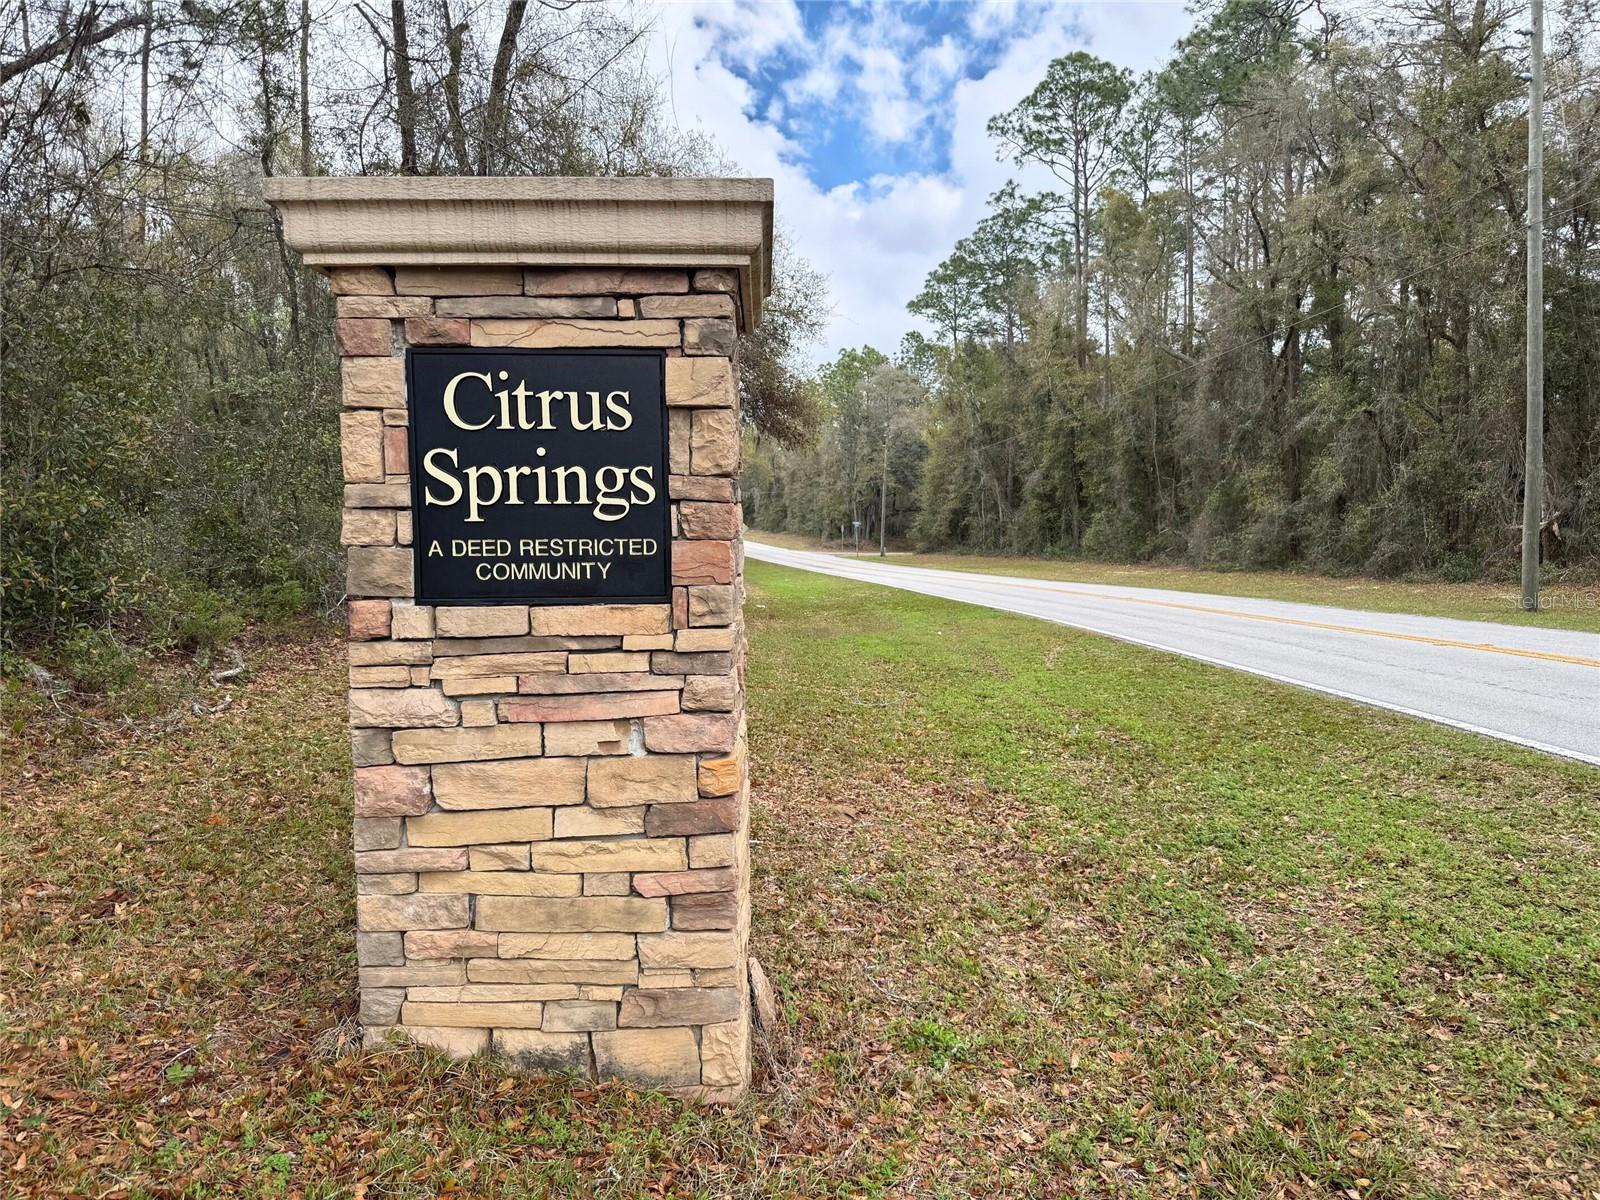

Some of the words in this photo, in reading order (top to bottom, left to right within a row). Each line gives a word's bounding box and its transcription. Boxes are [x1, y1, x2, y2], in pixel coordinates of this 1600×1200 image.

[443, 370, 634, 432] Citrus
[423, 447, 657, 523] Springs
[428, 540, 443, 557] A
[452, 539, 512, 557] DEED
[520, 538, 658, 556] RESTRICTED
[476, 562, 612, 581] COMMUNITY
